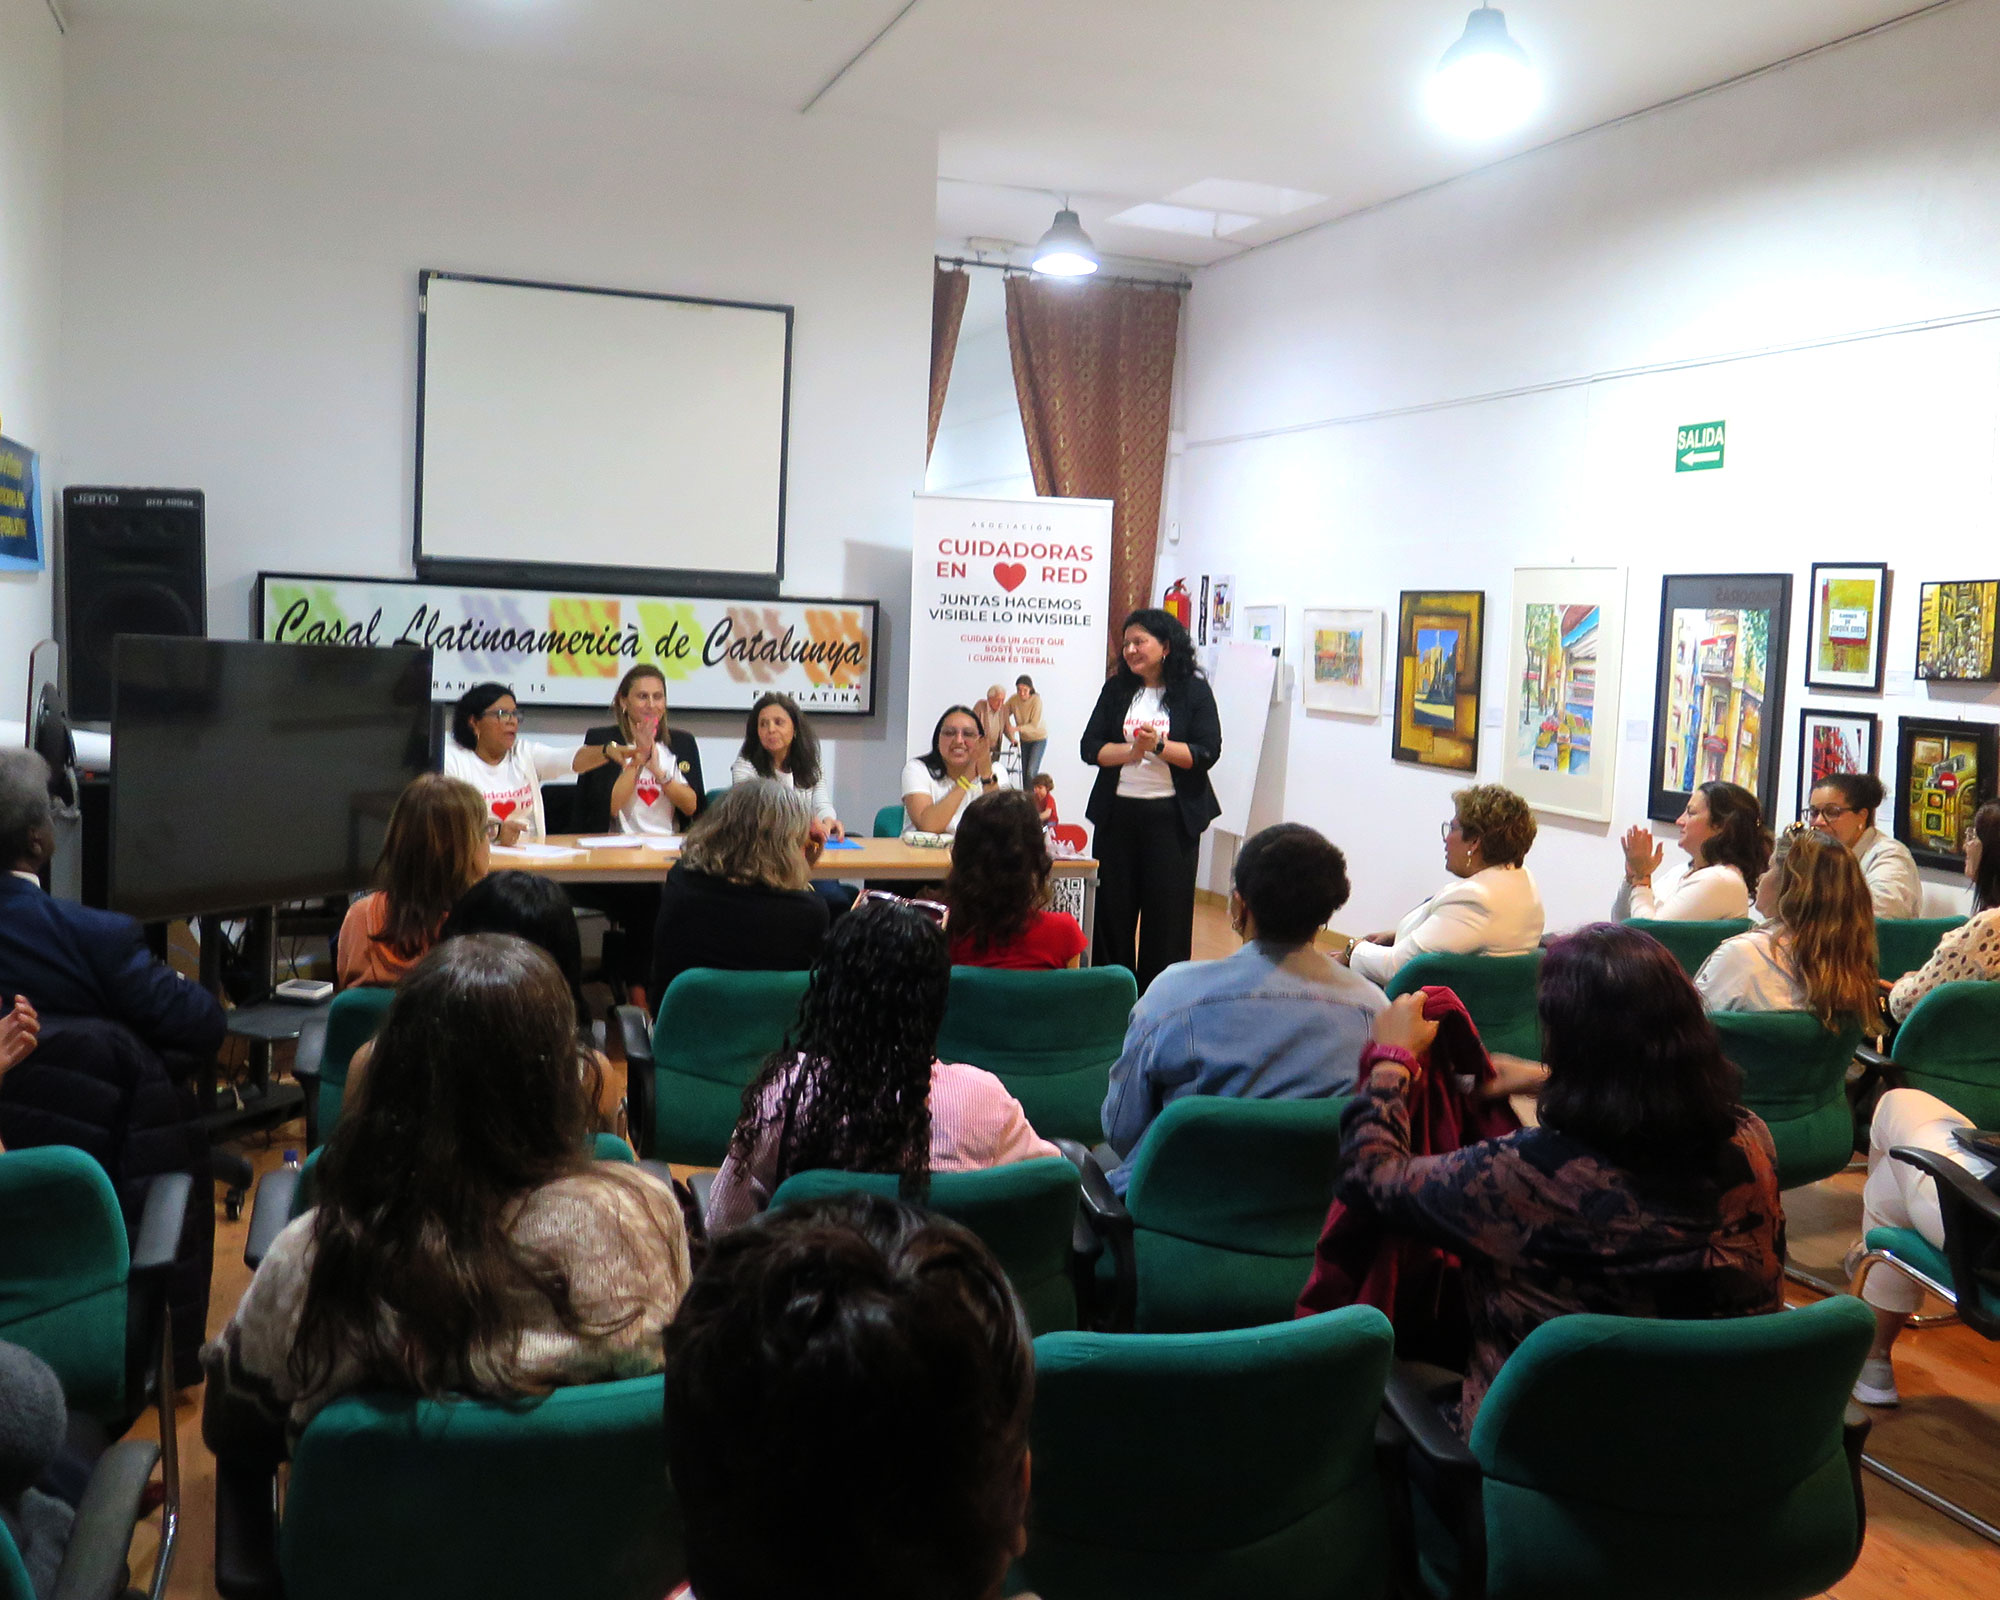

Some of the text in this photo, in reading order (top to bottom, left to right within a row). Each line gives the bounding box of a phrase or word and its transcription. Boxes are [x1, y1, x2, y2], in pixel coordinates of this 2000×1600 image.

[1678, 426, 1725, 450] SALIDA
[971, 521, 1052, 531] ASOCIACIÓN
[938, 538, 1093, 562] CUIDADORAS
[936, 561, 1088, 584] EN RED
[939, 593, 1082, 611] JUNTAS HACEMOS
[929, 609, 1092, 627] VISIBLE LO INVISIBLE
[275, 598, 864, 676] Casal Llatinoamericà de Catalunya
[960, 634, 993, 643] CUIDAR
[1008, 635, 1020, 644] UN
[1022, 636, 1045, 645] ACTE
[1047, 637, 1065, 646] QUE
[1015, 646, 1041, 655] VIDES
[973, 655, 1006, 663] CUIDAR
[1021, 656, 1056, 665] TREBALL
